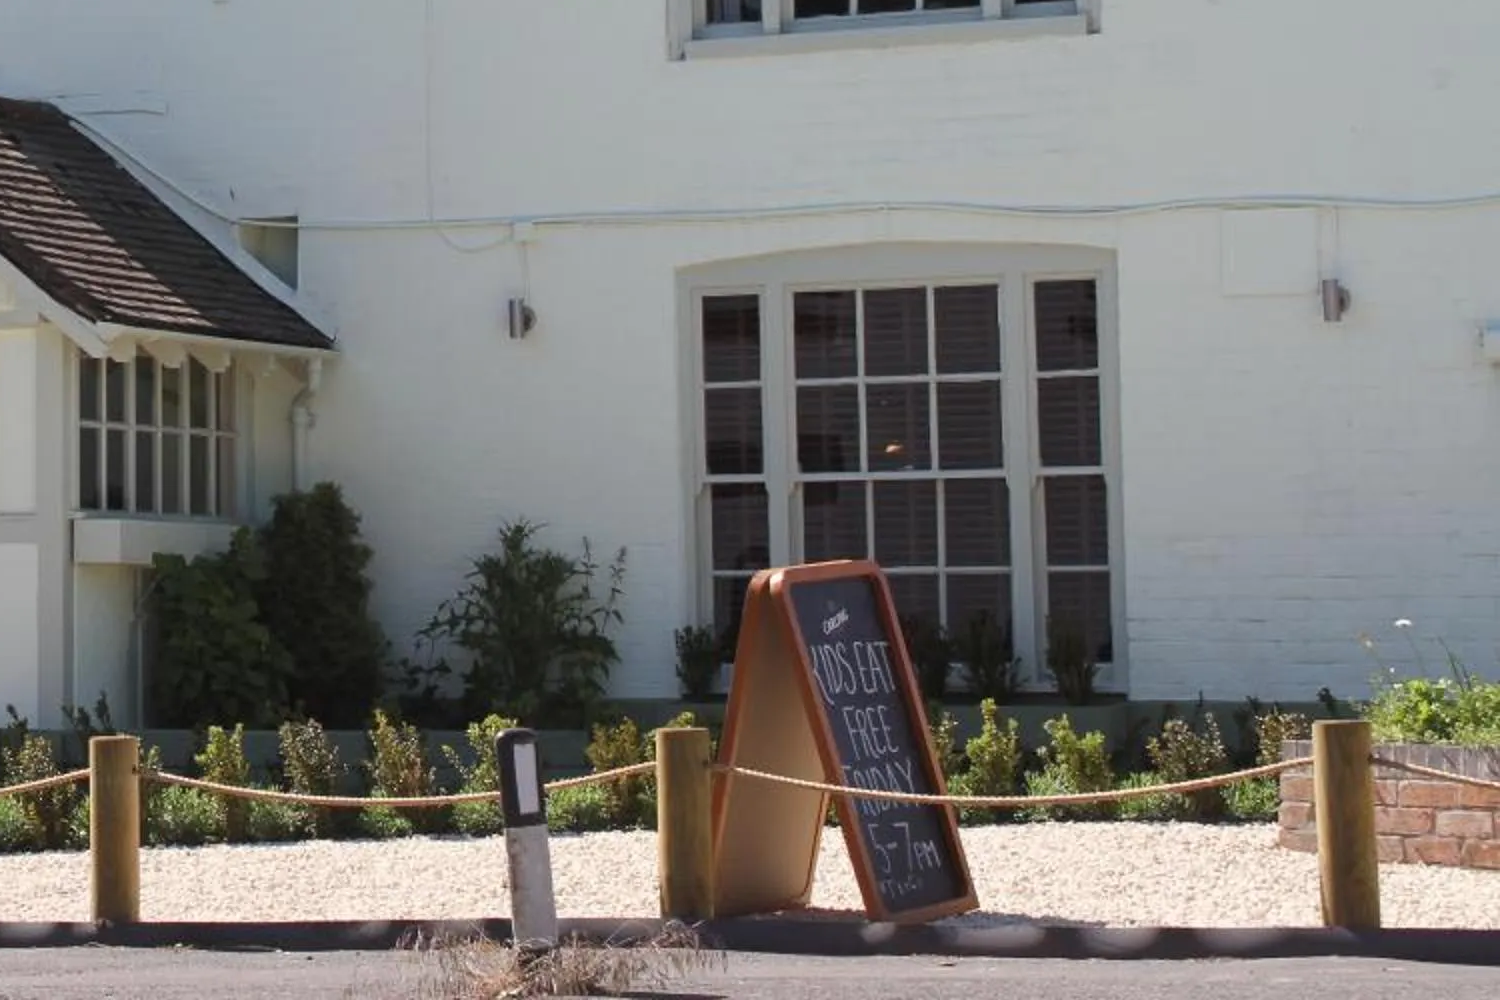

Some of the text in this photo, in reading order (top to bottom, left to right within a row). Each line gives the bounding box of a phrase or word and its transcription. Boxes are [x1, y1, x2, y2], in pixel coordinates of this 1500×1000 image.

[810, 641, 896, 705] KIDS EAT
[842, 705, 899, 760] FREE
[840, 757, 919, 817] FRIDAY
